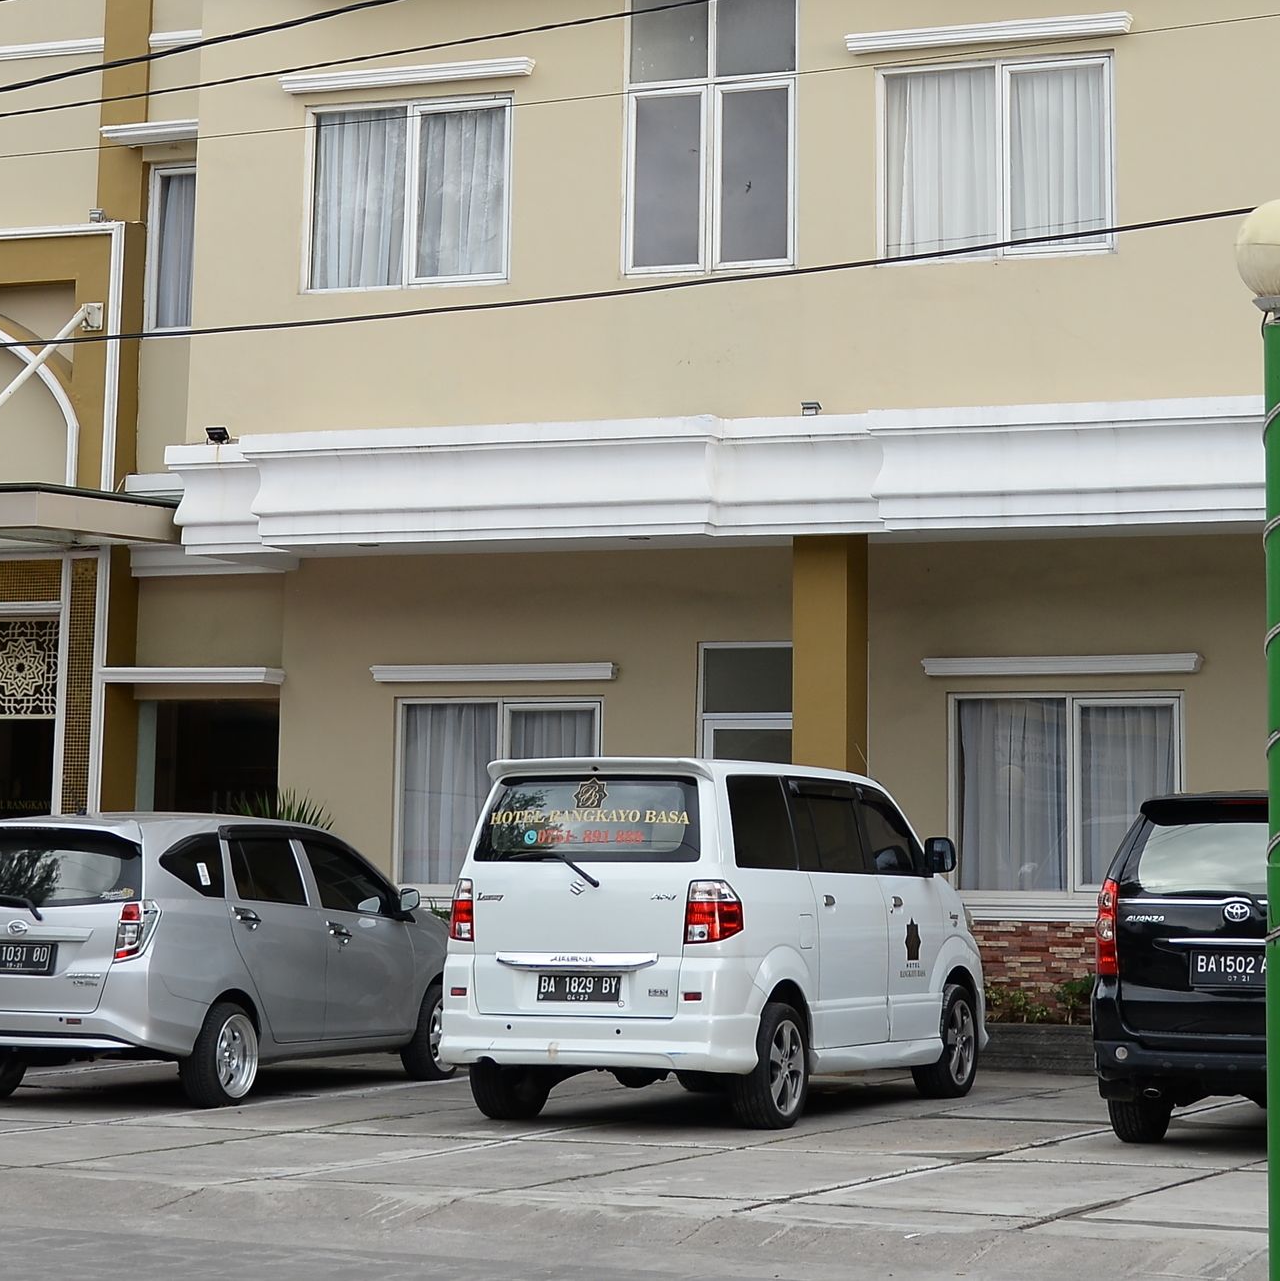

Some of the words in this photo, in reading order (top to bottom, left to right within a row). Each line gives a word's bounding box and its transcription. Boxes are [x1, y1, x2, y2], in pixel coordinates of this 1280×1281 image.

[489, 810, 545, 825] HOTEL
[549, 809, 641, 824] RANGKAYO
[644, 810, 690, 825] BASA
[1126, 915, 1165, 923] AVANZA
[2, 946, 27, 962] 1031
[1197, 955, 1216, 973] BA
[1220, 956, 1255, 974] 1502
[540, 976, 555, 993] BA
[565, 976, 594, 994] 1829
[602, 977, 618, 994] BY
